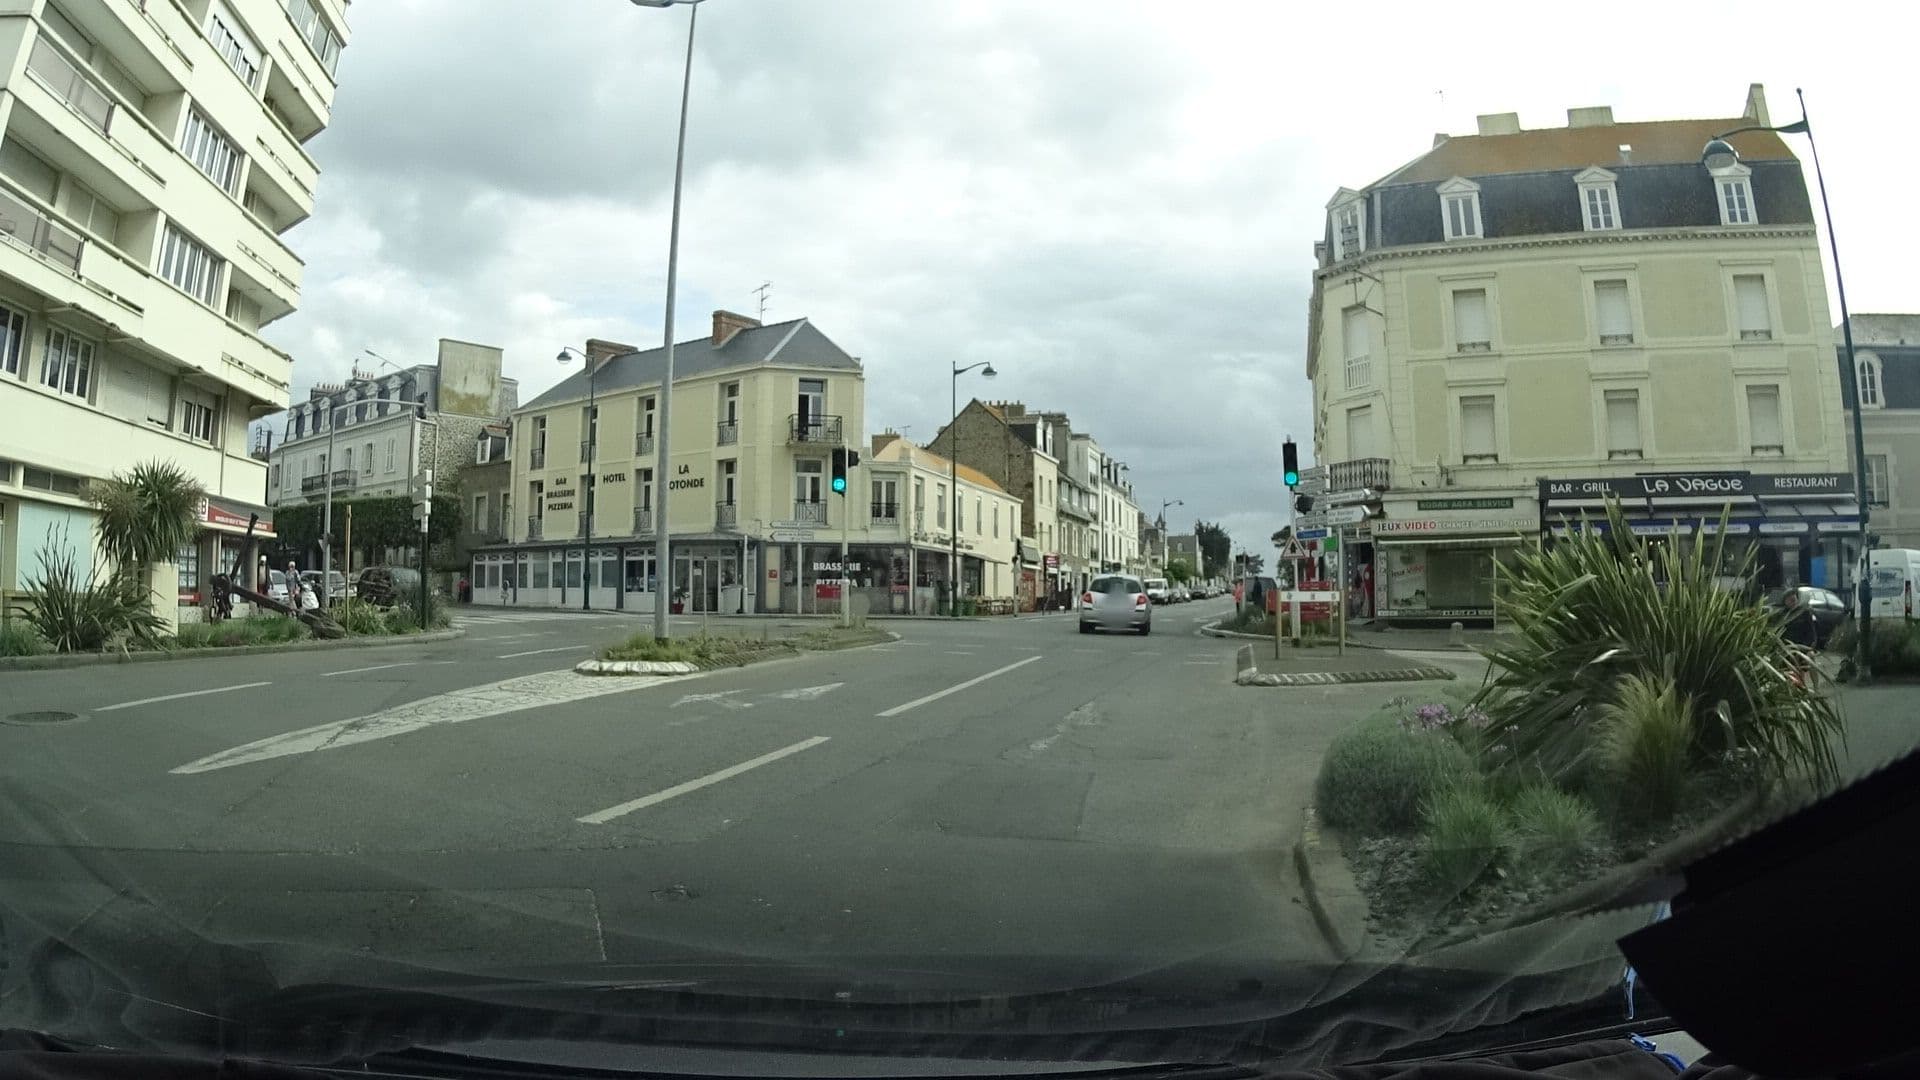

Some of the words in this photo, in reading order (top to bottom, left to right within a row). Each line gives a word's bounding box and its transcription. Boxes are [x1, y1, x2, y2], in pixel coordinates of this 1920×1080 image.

[678, 464, 690, 475] LA
[555, 477, 567, 486] BAR
[603, 473, 626, 484] HOTEL
[668, 478, 705, 490] OTONDE
[1774, 477, 1838, 489] RESTAURANT
[1551, 483, 1572, 493] BAR
[1582, 482, 1611, 493] GRILL
[1643, 478, 1669, 493] LA
[546, 489, 575, 499] BRASSERIE
[548, 502, 573, 511] PIZZERIA
[1420, 501, 1448, 509] KODAK
[1477, 499, 1511, 508] SERVICE
[1378, 522, 1401, 532] JEUX
[1404, 521, 1437, 531] VIDEO
[813, 562, 861, 571] BRASSIE
